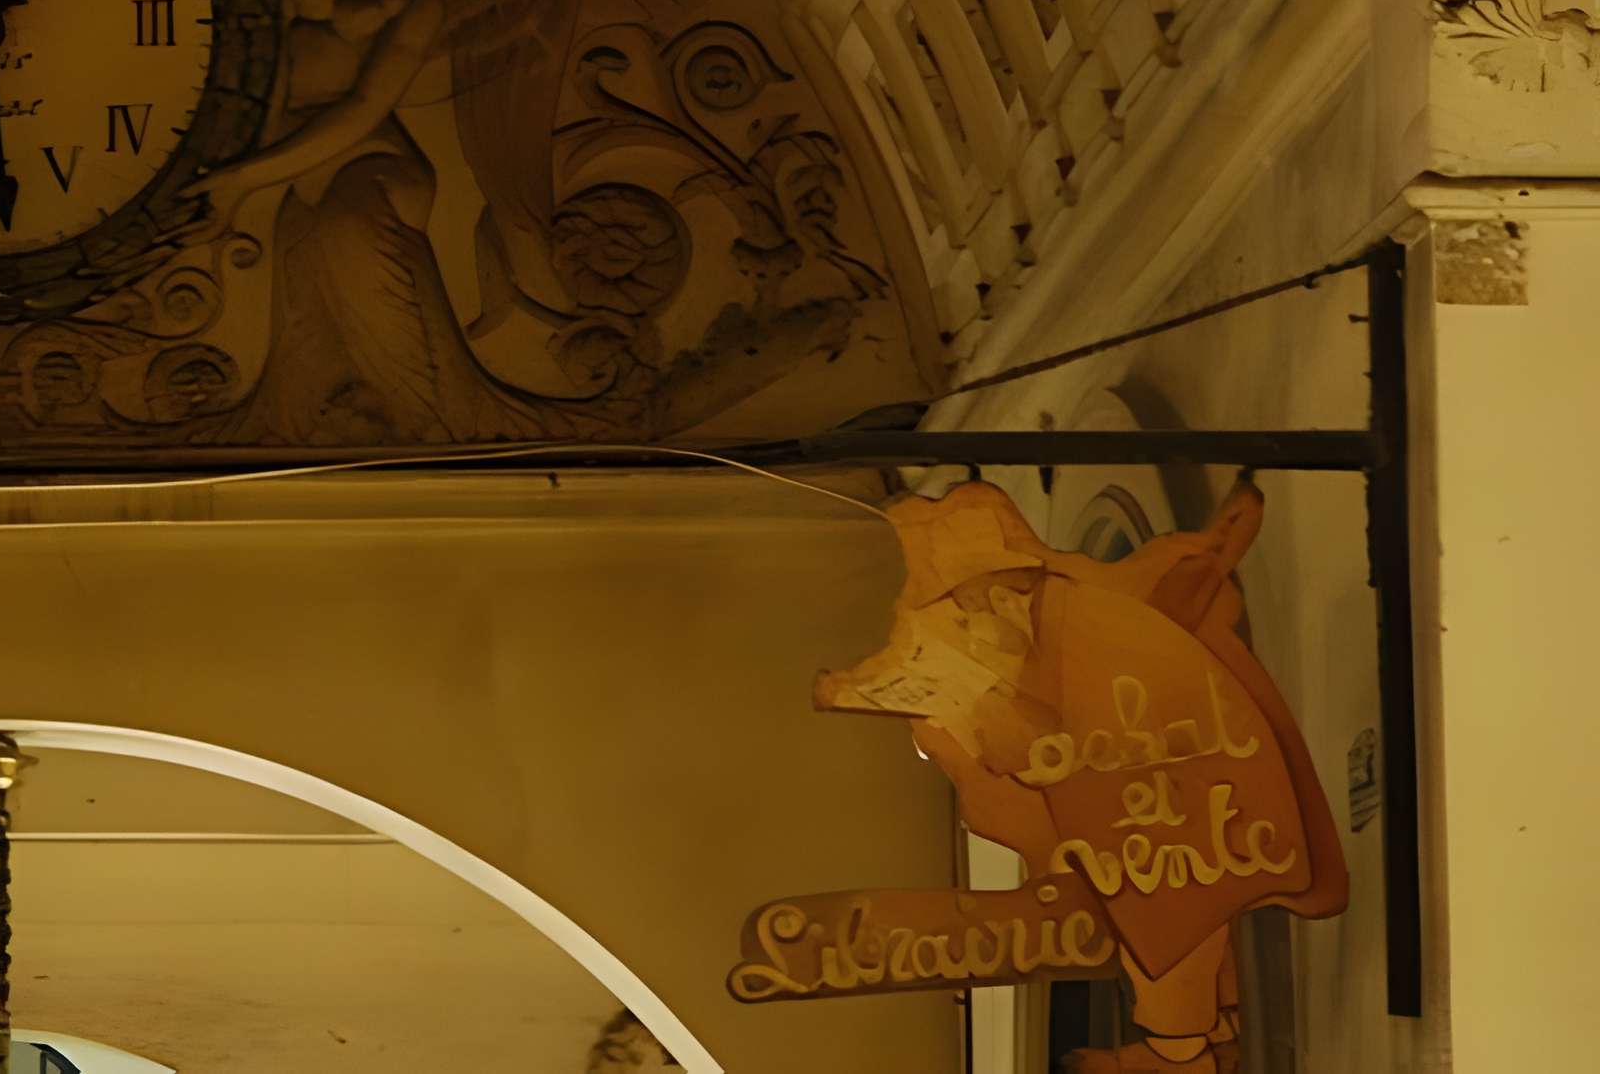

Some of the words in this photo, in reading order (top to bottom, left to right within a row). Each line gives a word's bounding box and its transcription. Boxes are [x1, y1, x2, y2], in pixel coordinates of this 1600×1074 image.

[105, 104, 152, 156] IV
[41, 146, 84, 193] V
[1110, 770, 1188, 828] et
